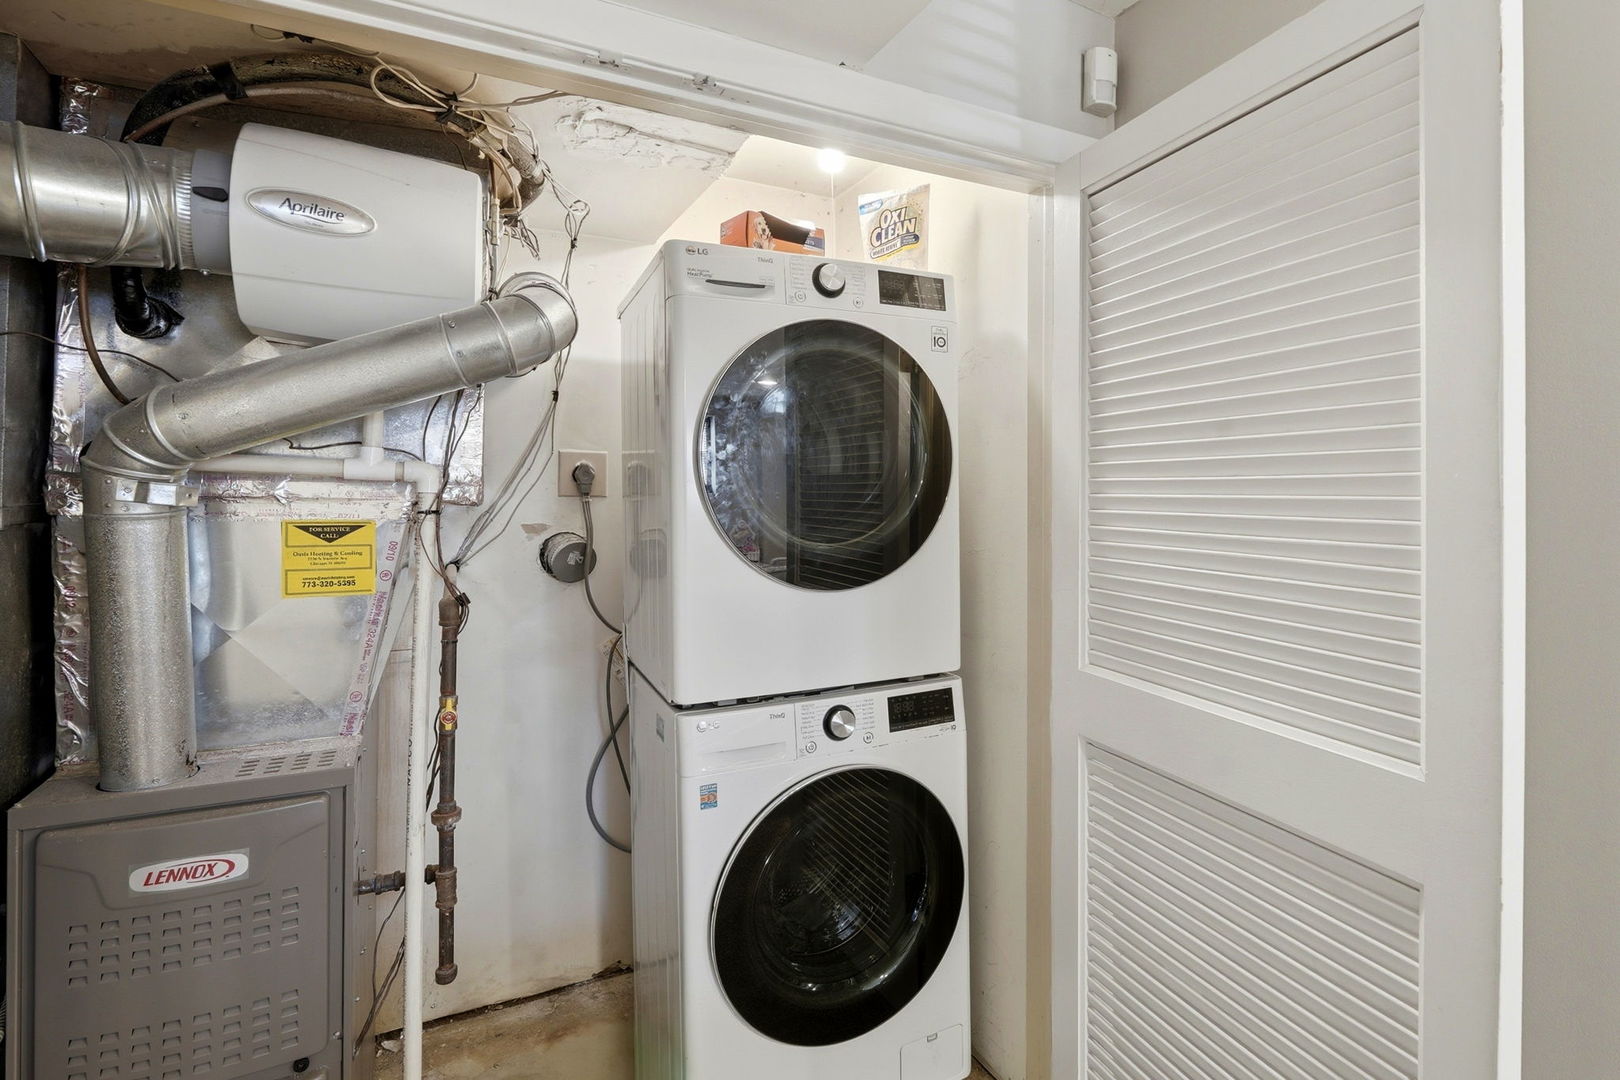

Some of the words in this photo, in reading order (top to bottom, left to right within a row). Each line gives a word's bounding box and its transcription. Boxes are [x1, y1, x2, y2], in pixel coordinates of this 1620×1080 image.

[279, 197, 345, 222] Aprilaire
[879, 206, 907, 228] OXI
[870, 217, 917, 248] CLEAN
[386, 541, 398, 561] 09/10
[364, 626, 377, 649] 324A
[143, 862, 218, 887] LENNOX
